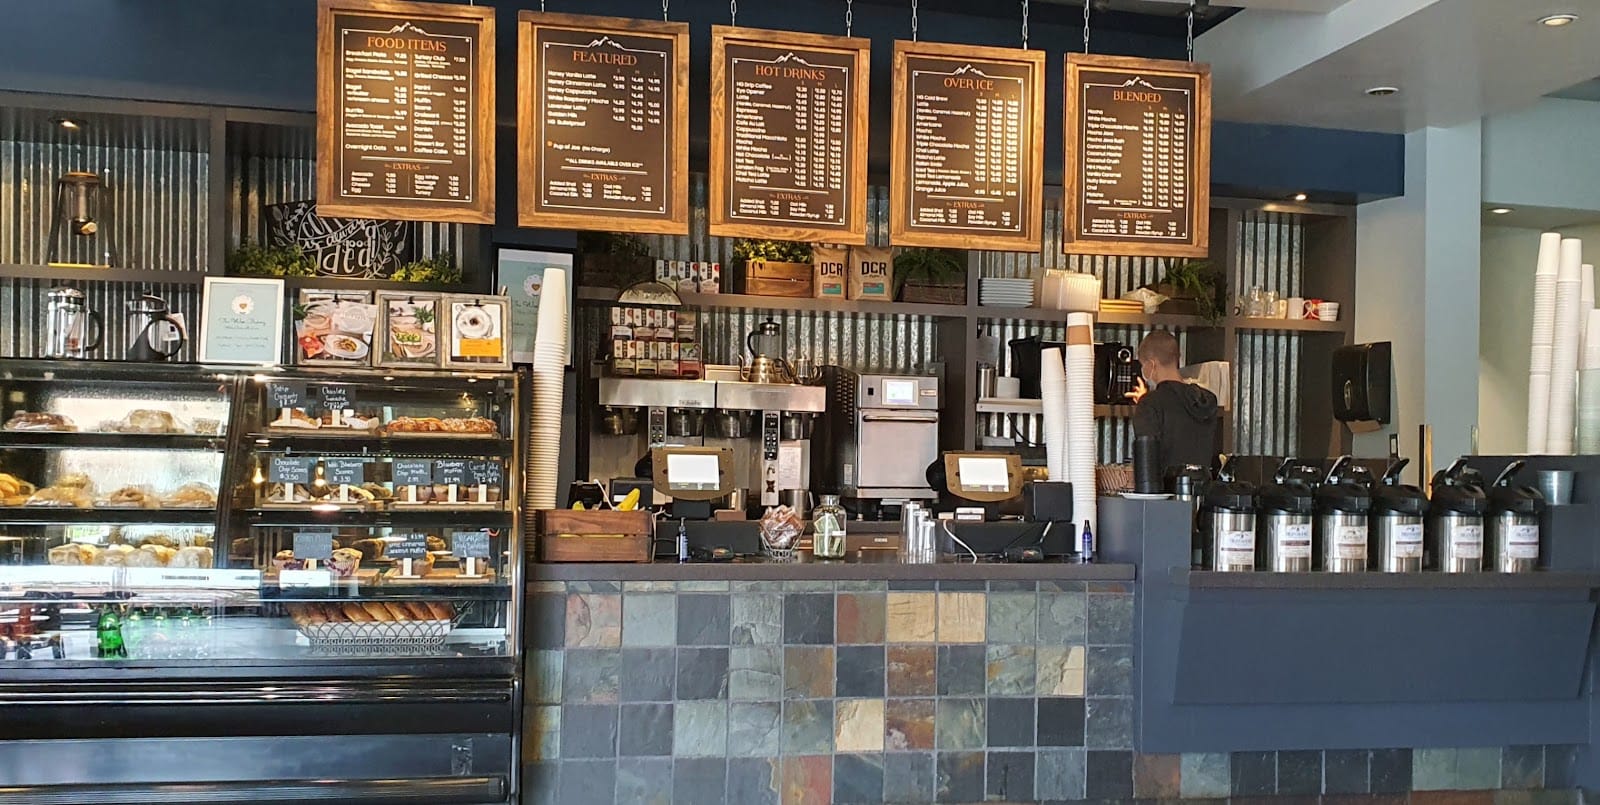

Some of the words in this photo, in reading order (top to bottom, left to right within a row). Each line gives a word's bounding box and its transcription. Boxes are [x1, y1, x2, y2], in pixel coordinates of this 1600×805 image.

[367, 36, 405, 49] FOOD
[409, 38, 448, 52] ITEMS
[573, 51, 638, 66] FEATURED
[755, 64, 780, 77] HOT
[784, 68, 825, 81] DRINKS
[944, 78, 975, 90] OVER
[976, 80, 994, 92] ICE
[1113, 90, 1162, 102] BLENDED
[392, 163, 421, 171] EXTRAS
[591, 173, 618, 182] EXTRAS
[776, 193, 802, 202] EXTRAS
[953, 201, 977, 210] EXTRAS
[1123, 212, 1147, 220] EXTRAS
[820, 261, 844, 278] DCR
[861, 260, 888, 277] DCR
